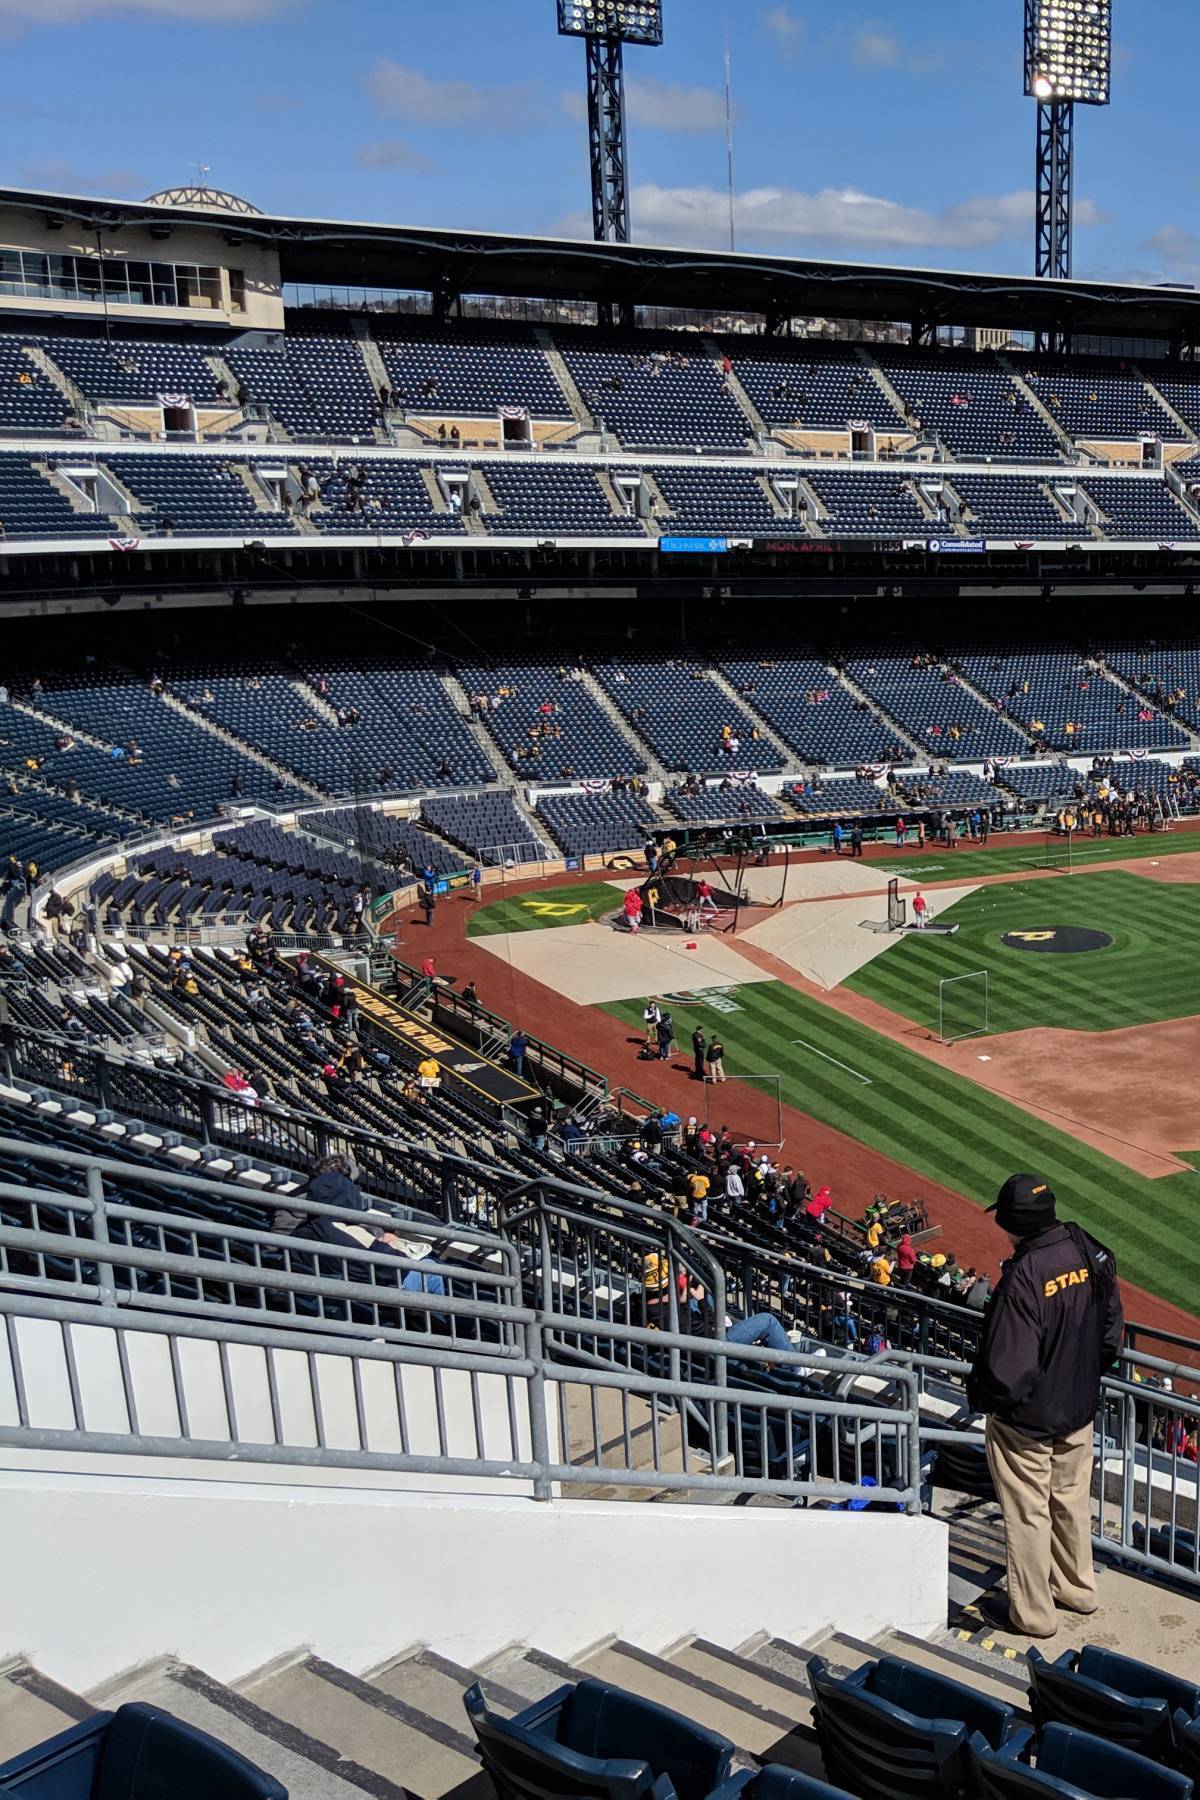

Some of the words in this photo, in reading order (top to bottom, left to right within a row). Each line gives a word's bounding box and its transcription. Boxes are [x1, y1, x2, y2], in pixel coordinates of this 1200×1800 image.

[801, 542, 833, 552] APRIL
[872, 541, 901, 551] 11:55
[392, 1020, 429, 1036] PNC
[412, 1033, 456, 1054] PARK
[1032, 1184, 1047, 1194] STAFF
